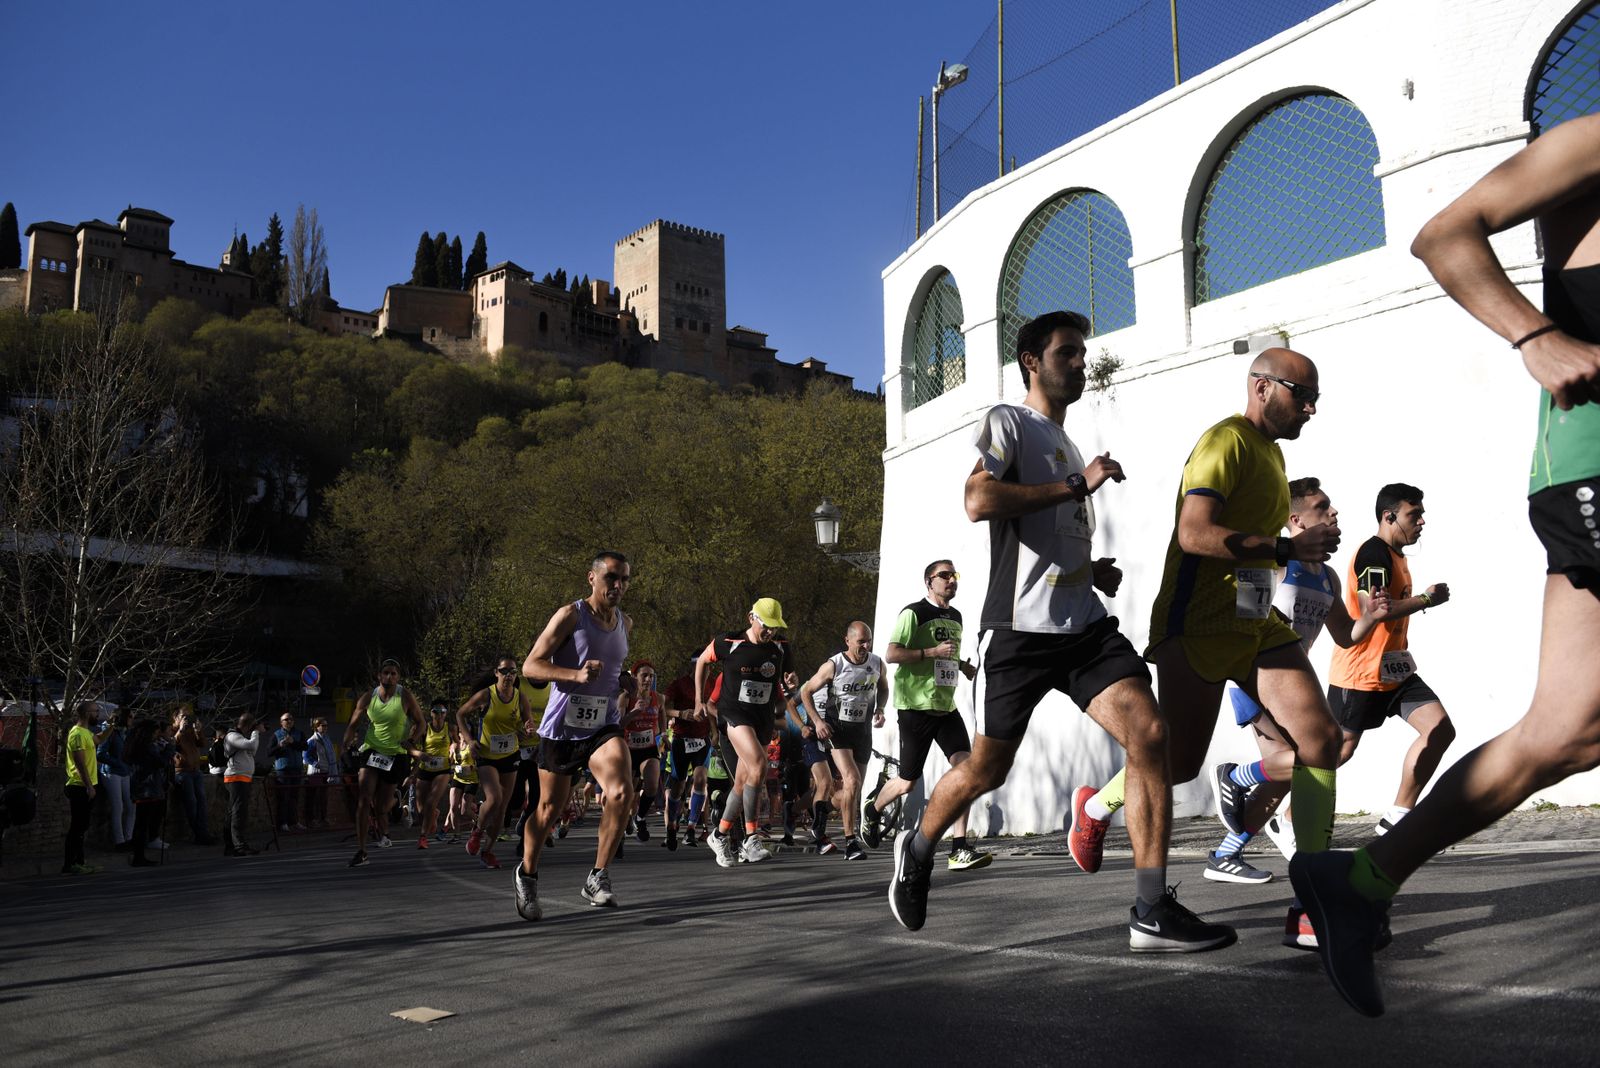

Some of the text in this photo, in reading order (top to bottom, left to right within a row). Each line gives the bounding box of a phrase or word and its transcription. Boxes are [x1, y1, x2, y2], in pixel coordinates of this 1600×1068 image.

[1255, 587, 1271, 605] 77
[1384, 661, 1411, 674] 1689
[940, 670, 955, 680] 369
[746, 688, 764, 698] 534
[576, 707, 599, 720] 351
[844, 708, 864, 718] 1569
[632, 736, 650, 744] 1036
